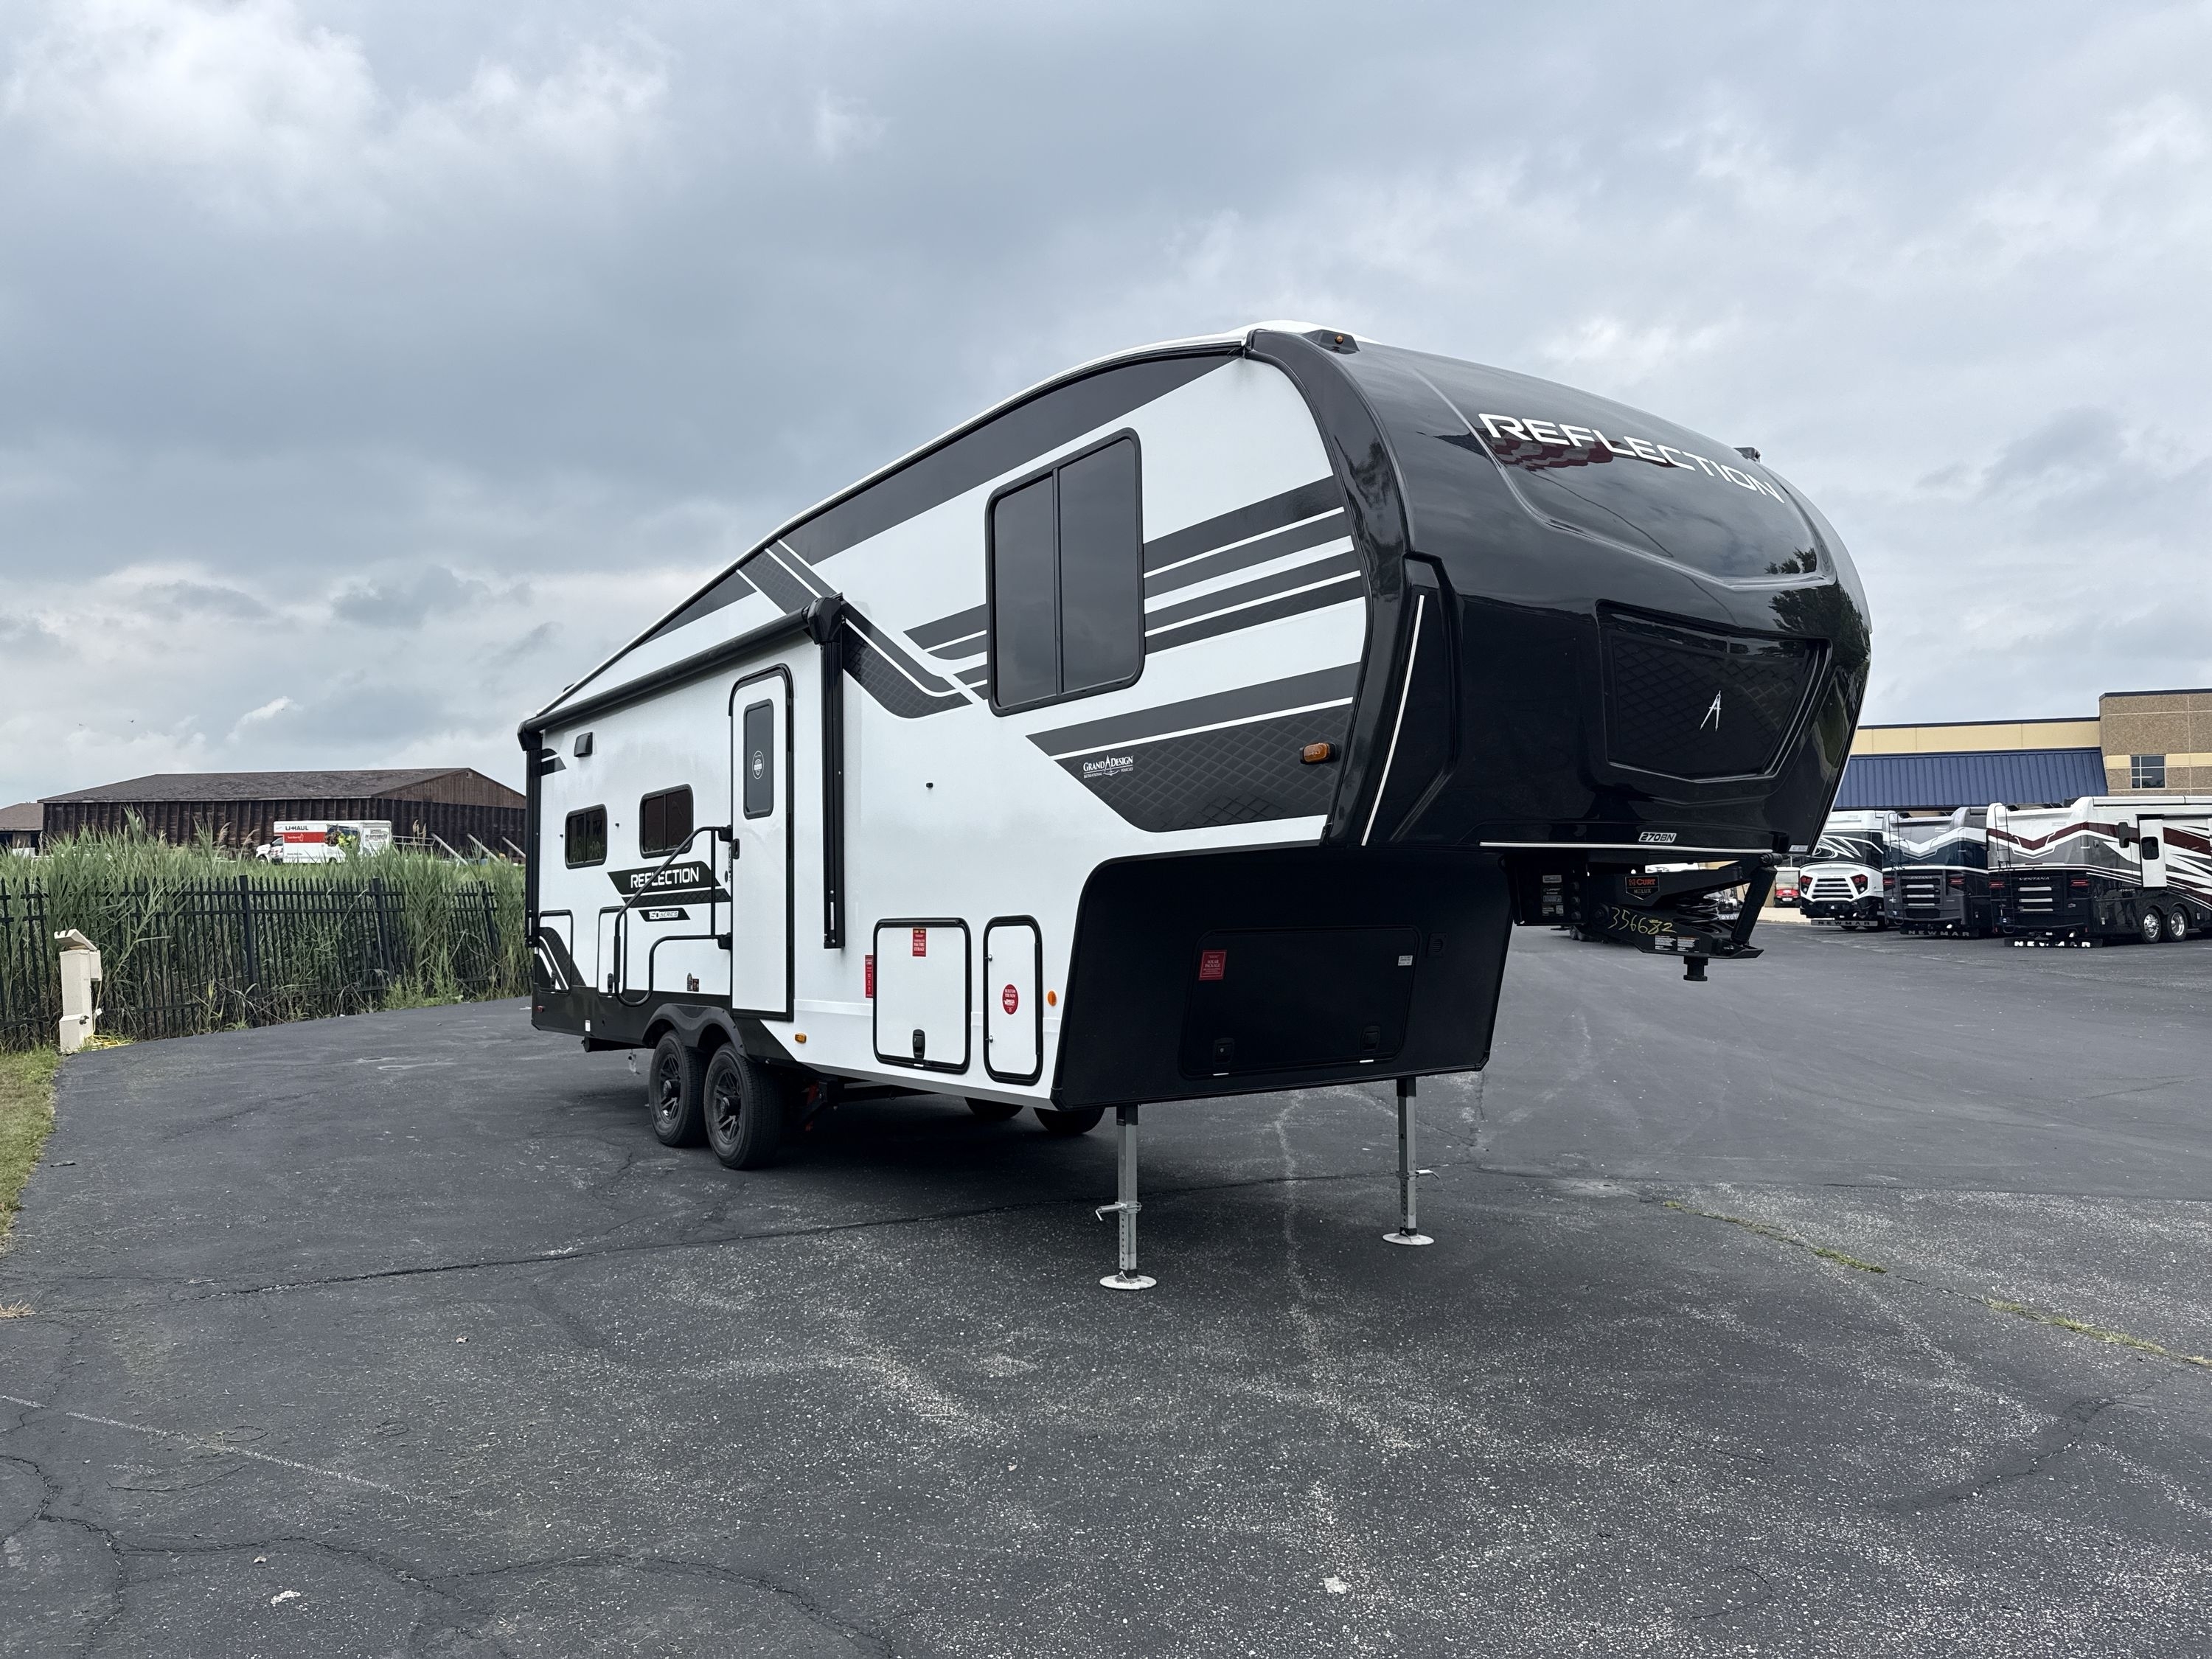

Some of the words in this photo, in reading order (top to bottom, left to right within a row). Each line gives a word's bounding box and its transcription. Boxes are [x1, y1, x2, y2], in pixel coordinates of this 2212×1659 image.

[1478, 412, 1785, 504] REFLECTION
[1083, 761, 1105, 772] GRAND
[1111, 756, 1133, 767] DESIGN
[1639, 832, 1676, 842] 270BN
[1608, 907, 1677, 935] 356682
